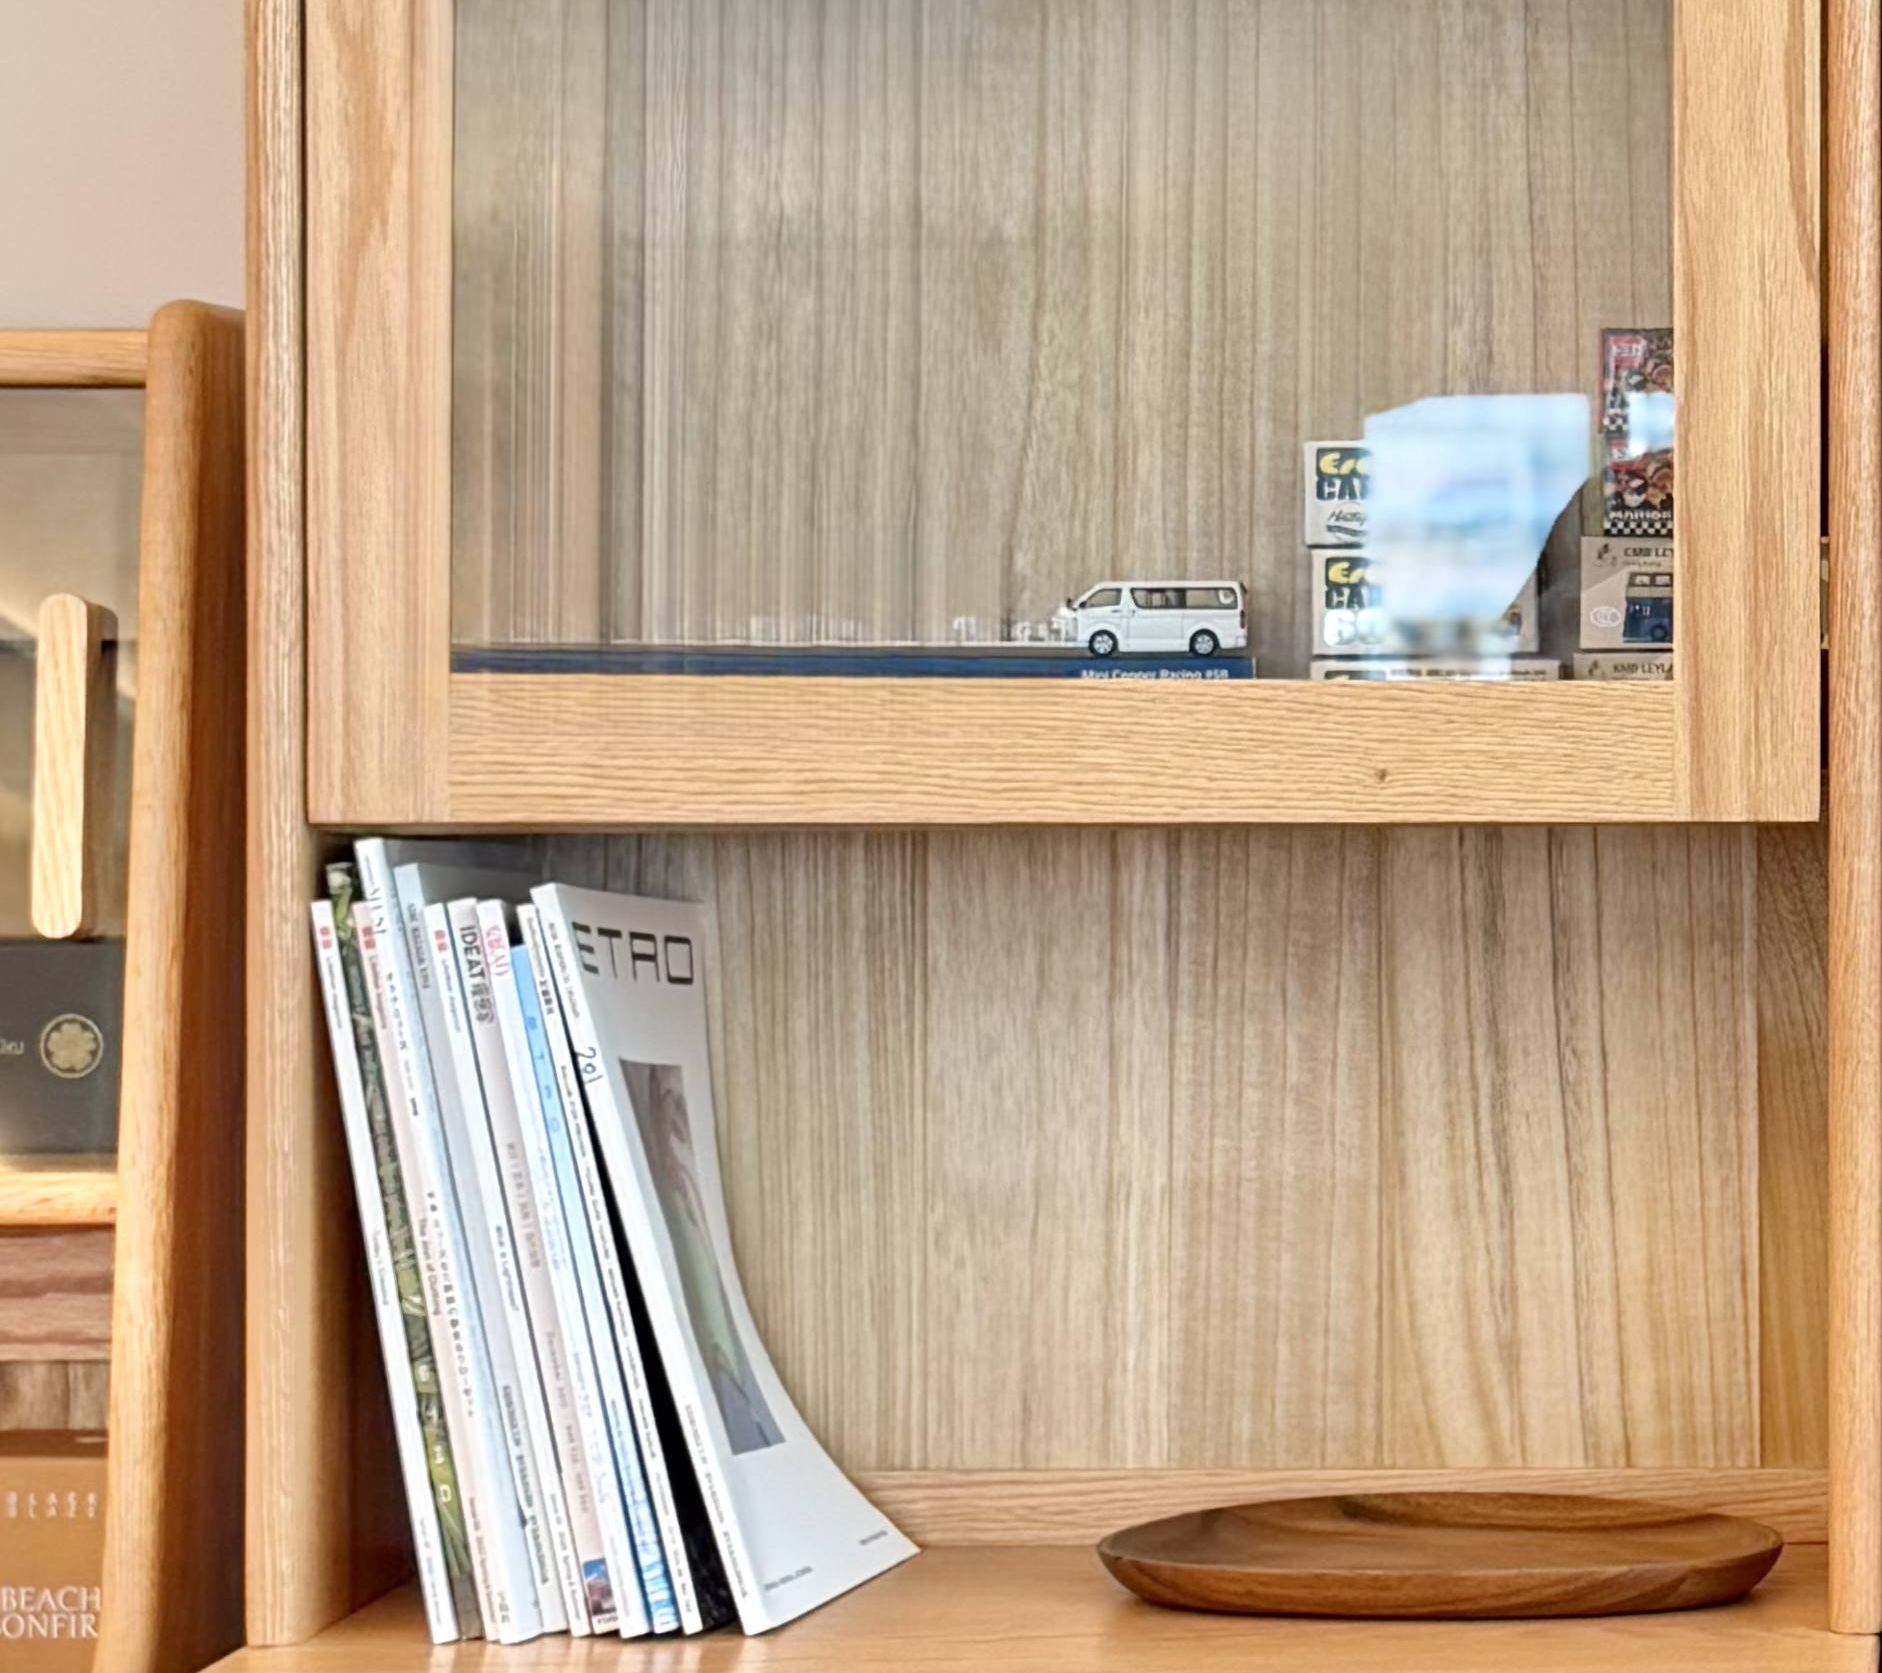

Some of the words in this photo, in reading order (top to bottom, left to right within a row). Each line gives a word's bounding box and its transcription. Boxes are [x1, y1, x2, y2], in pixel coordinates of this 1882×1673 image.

[460, 926, 486, 978] IDEAT
[1, 1586, 102, 1612] BEACH
[0, 1613, 99, 1639] ONFIR
